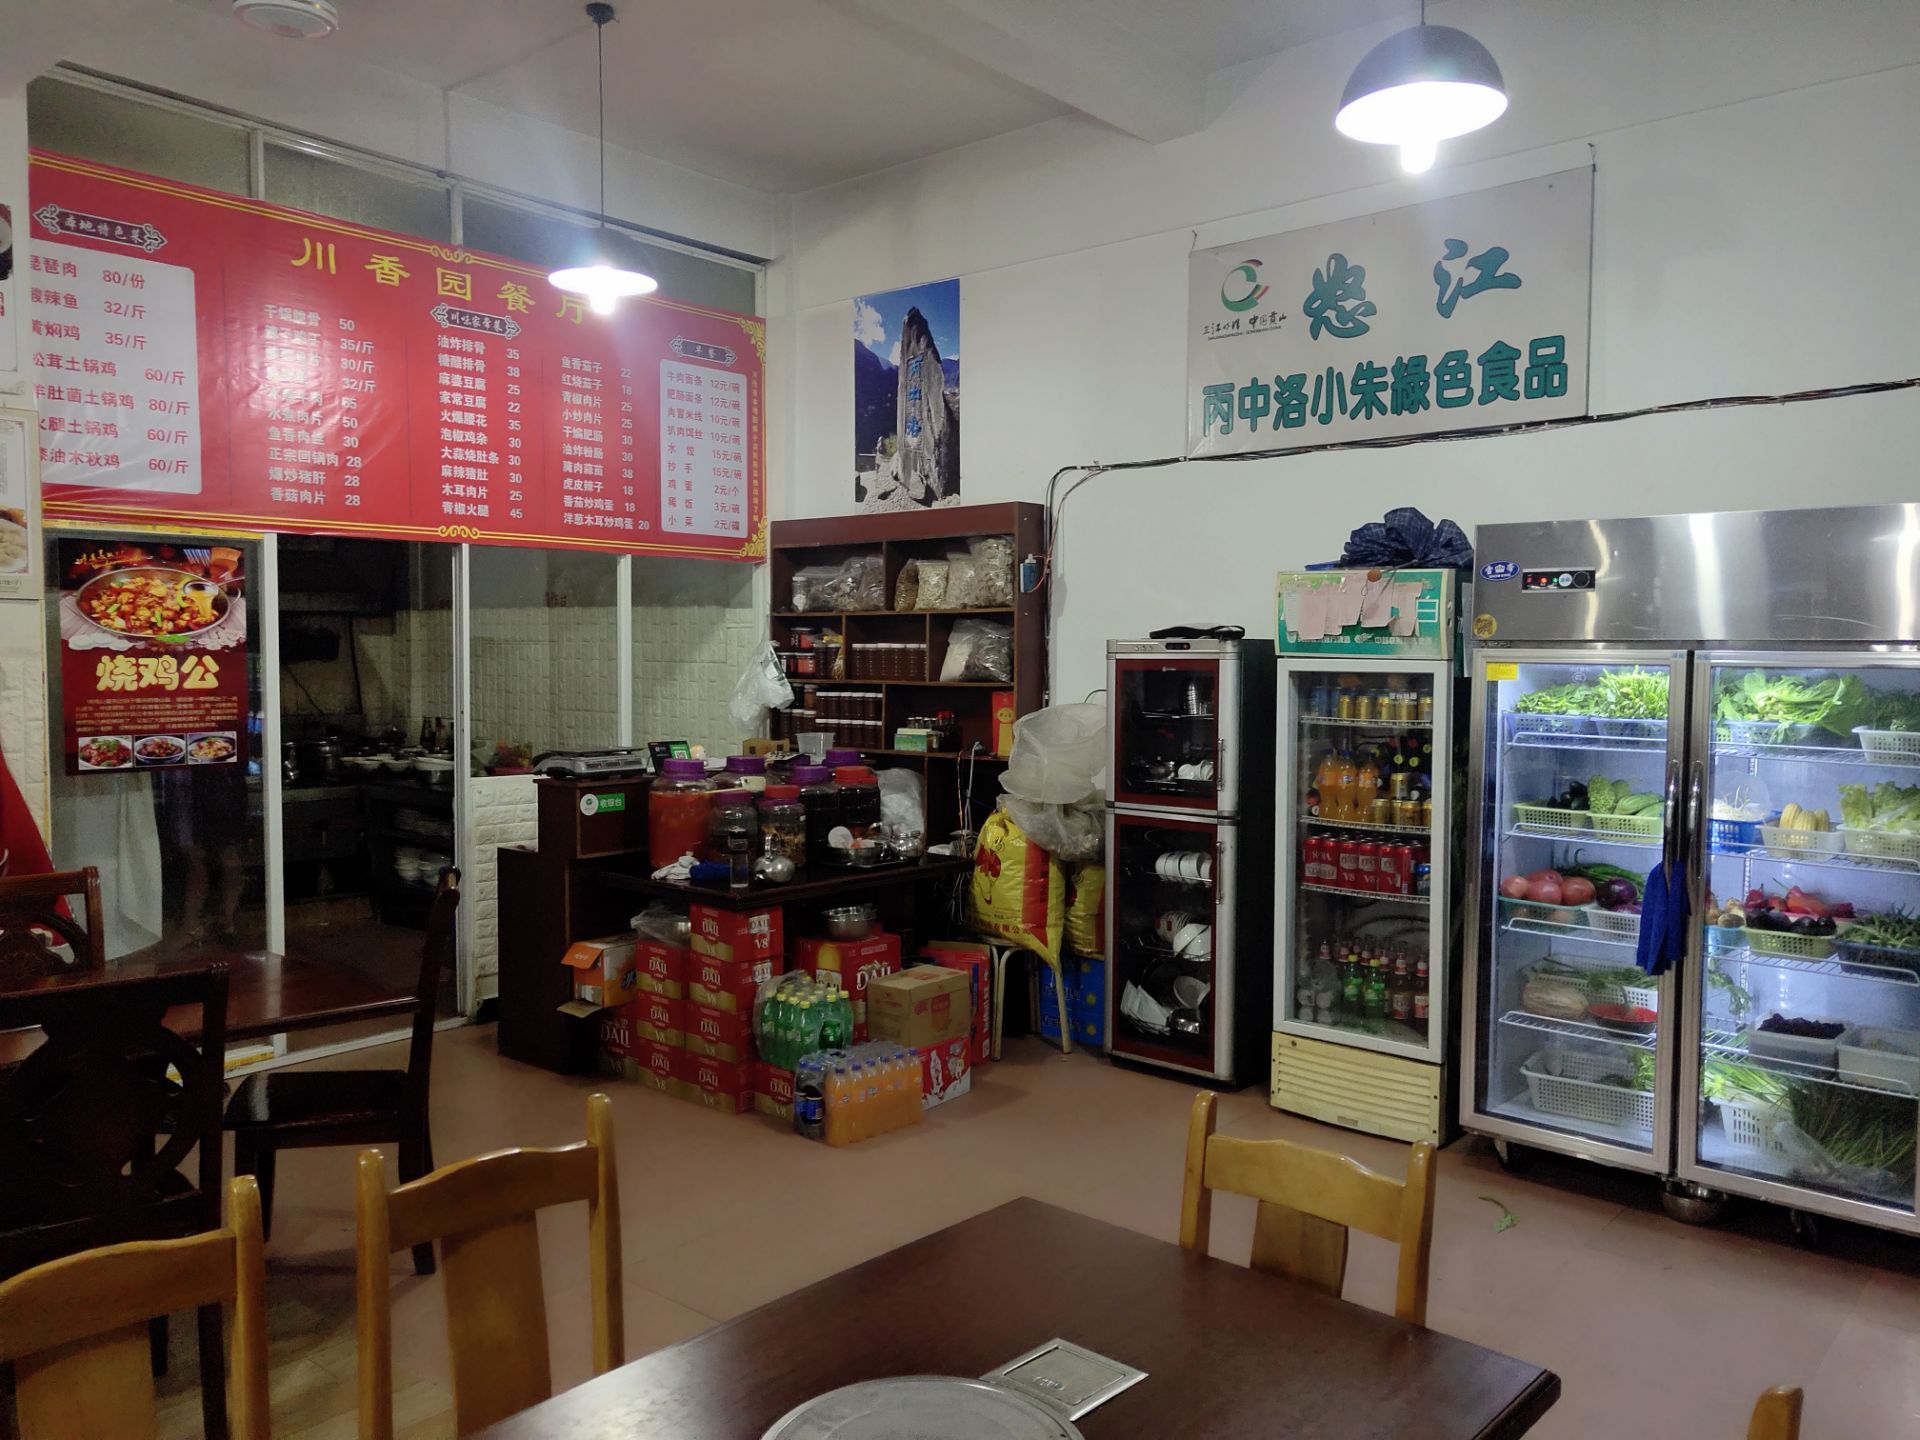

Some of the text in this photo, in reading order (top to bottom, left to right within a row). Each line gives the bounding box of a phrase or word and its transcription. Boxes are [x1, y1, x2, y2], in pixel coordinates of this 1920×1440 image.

[102, 269, 145, 290] 80/份
[103, 300, 147, 320] 32/斤
[339, 317, 356, 333] 50
[105, 331, 148, 351] 35/斤
[340, 337, 375, 355] 35/斤
[437, 334, 520, 360] 油炸排骨 35
[340, 356, 376, 375] 30/斤
[506, 365, 520, 378] 38
[144, 367, 186, 386] 60/斤
[342, 376, 377, 393] 32/斤
[507, 383, 520, 396] 25
[148, 397, 191, 416] 80/斤
[439, 390, 521, 414] 家常豆腐 22
[621, 401, 633, 412] 25
[342, 416, 359, 430] 50
[508, 419, 521, 431] 35
[621, 418, 634, 430] 25
[146, 427, 189, 446] 60/斤
[268, 426, 359, 449] 鱼香肉丝 30
[508, 437, 522, 449] 30
[621, 435, 634, 446] 30
[268, 446, 363, 469] 正宗回锅肉 28
[508, 454, 521, 467] 30
[148, 457, 190, 475] 60/斤
[344, 474, 361, 488] 28
[509, 472, 523, 485] 30
[269, 486, 361, 507] 香菇肉片 28
[441, 482, 523, 502] 木耳肉片 25
[623, 485, 635, 497] 18
[714, 484, 741, 497] 2元/个
[509, 508, 523, 519] 45
[624, 502, 637, 514] 18
[638, 520, 651, 531] 20
[96, 654, 220, 692] 烧鸡公
[755, 937, 769, 949] V8
